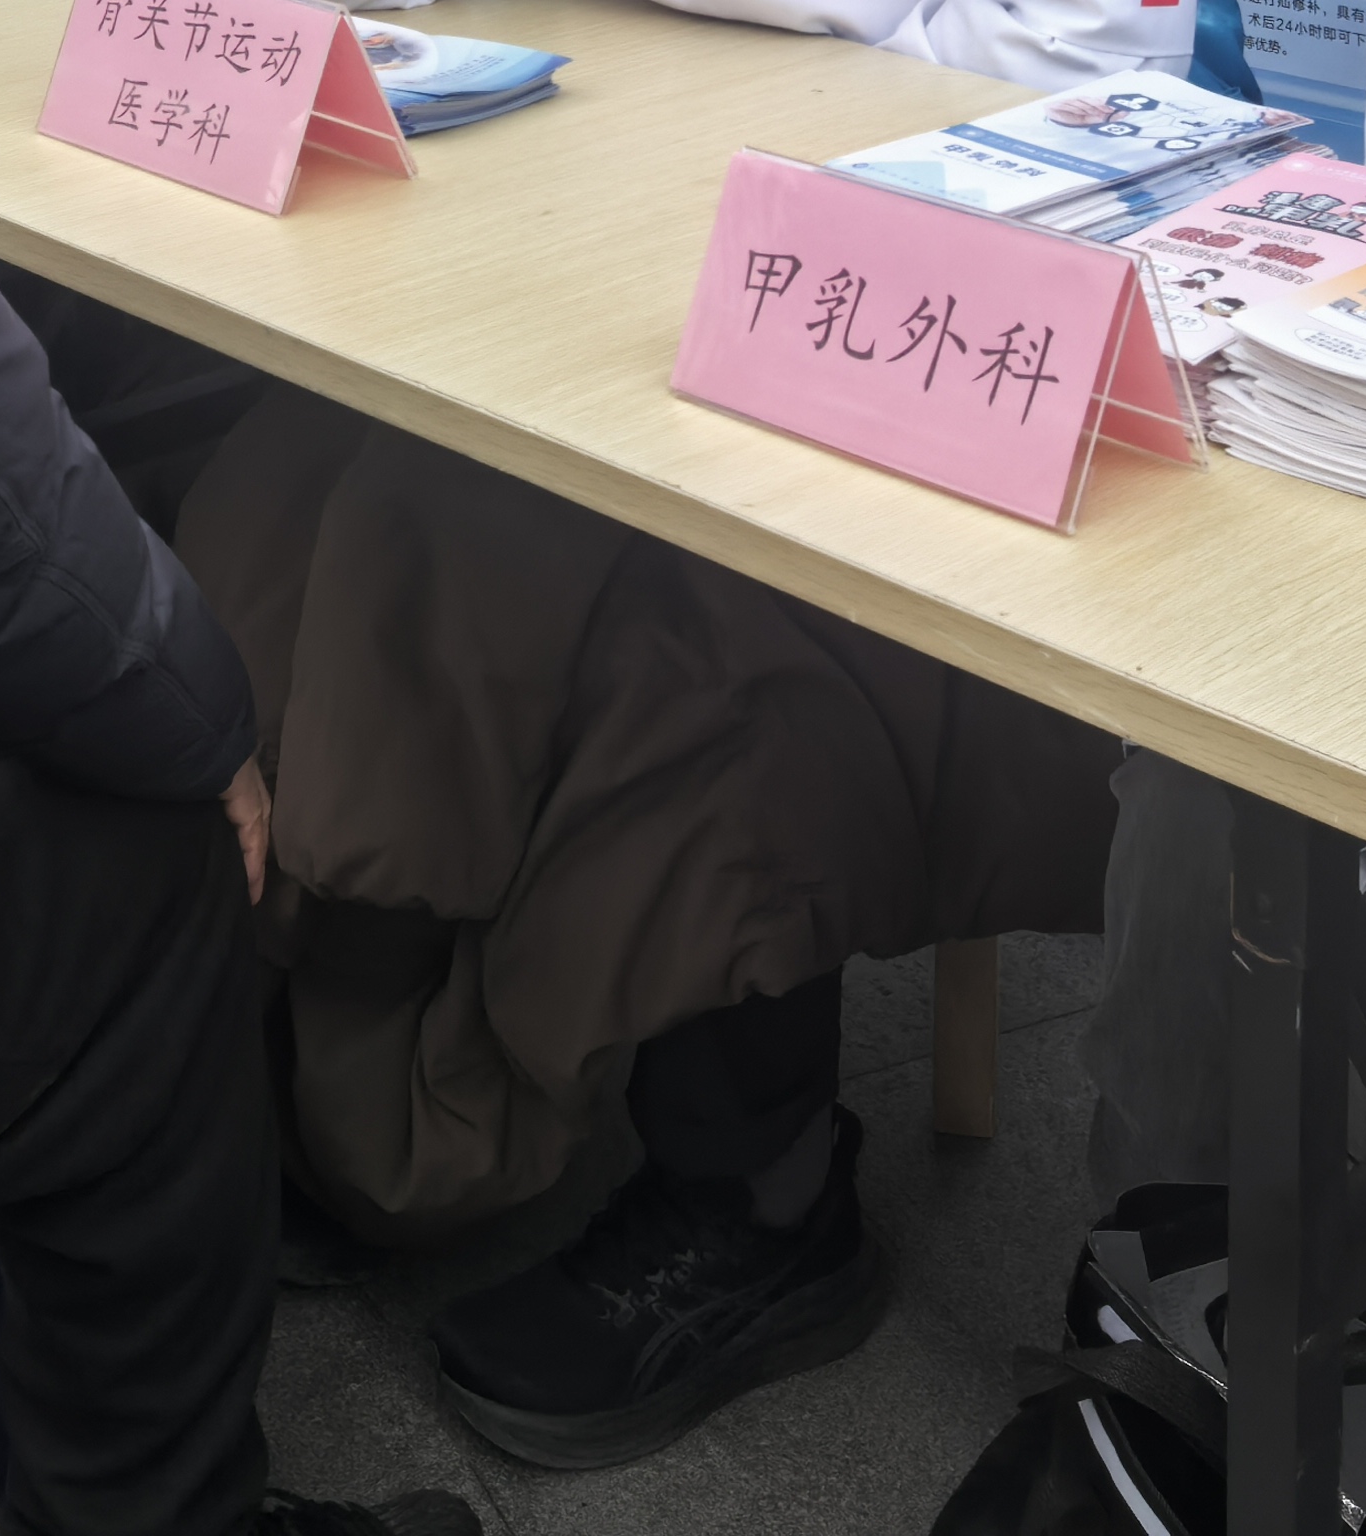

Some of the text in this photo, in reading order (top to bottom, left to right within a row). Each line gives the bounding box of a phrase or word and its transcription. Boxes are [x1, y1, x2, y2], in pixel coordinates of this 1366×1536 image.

[108, 77, 232, 165] 医学科
[743, 249, 1061, 427] 甲乳外科
